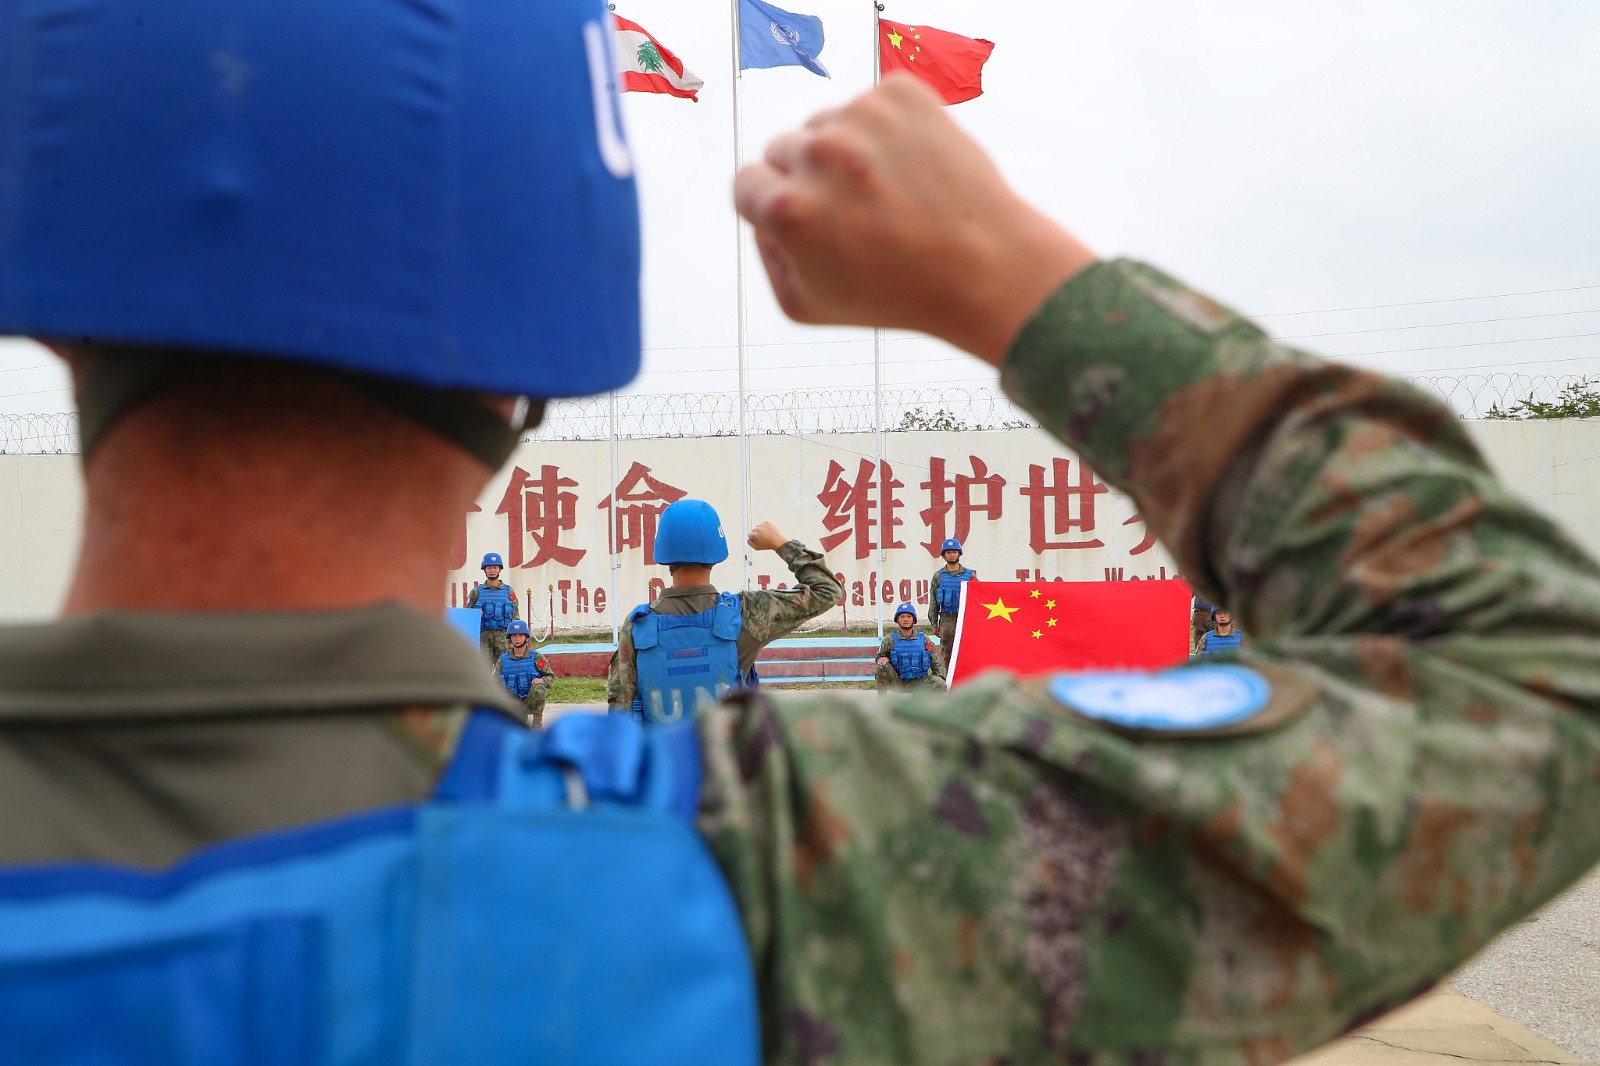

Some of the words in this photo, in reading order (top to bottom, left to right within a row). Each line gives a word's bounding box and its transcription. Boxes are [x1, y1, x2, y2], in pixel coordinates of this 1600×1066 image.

[816, 455, 1160, 562] 维护世
[557, 579, 607, 615] The
